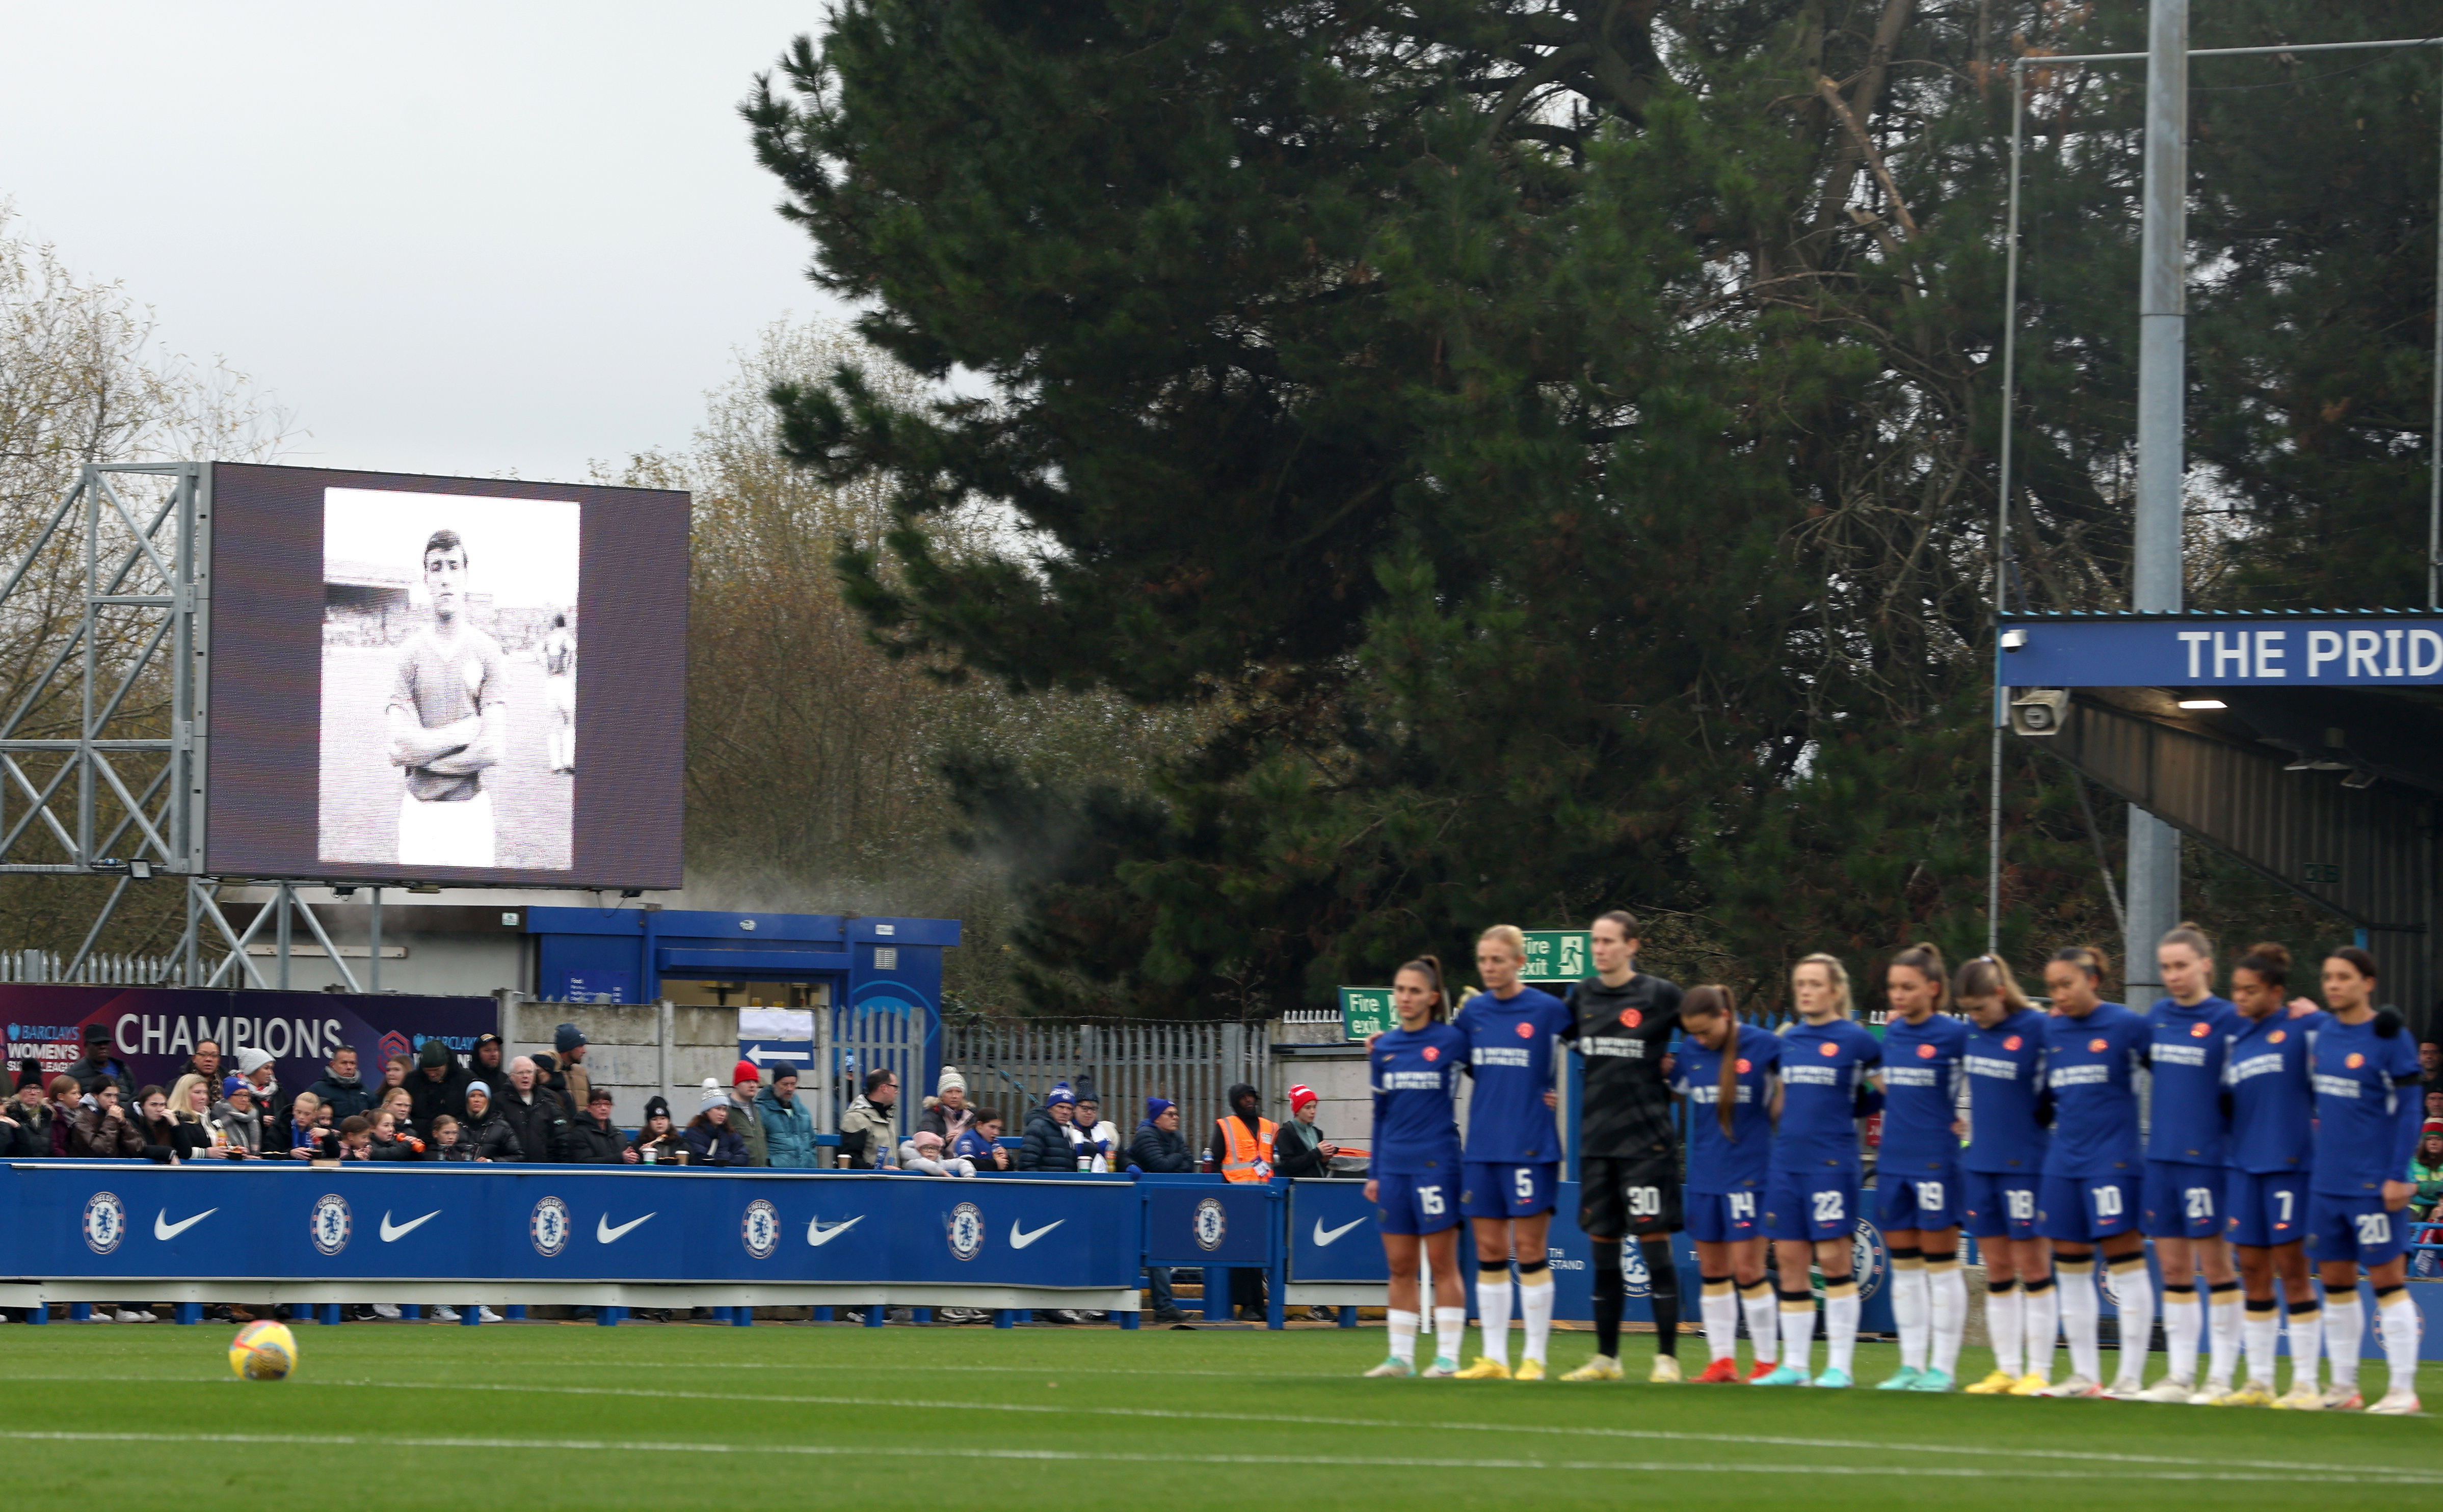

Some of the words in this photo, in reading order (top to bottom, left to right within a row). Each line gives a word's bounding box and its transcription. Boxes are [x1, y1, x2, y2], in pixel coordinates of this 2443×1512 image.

[2177, 631, 2287, 678] THE
[2307, 629, 2443, 677] PRID
[1349, 994, 1380, 1012] Fire
[22, 1025, 81, 1040] BARCLAYS
[115, 1013, 343, 1059] CHAMPIONS
[1352, 1016, 1381, 1034] exit
[7, 1043, 81, 1060] WOMEN'S
[40, 1062, 73, 1073] LEAG
[1515, 1168, 1533, 1197] 5
[1916, 1181, 1944, 1210] 19
[1417, 1185, 1445, 1214] 15
[1627, 1186, 1660, 1215] 30
[1726, 1191, 1756, 1220] 14
[1812, 1190, 1845, 1221] 22
[2004, 1190, 2034, 1219] 18
[2091, 1185, 2122, 1216] 10
[2184, 1187, 2214, 1219] 21
[2273, 1190, 2294, 1221] 7
[2355, 1213, 2392, 1244] 20
[1548, 1248, 1564, 1258] TH
[1548, 1260, 1586, 1270] STAND
